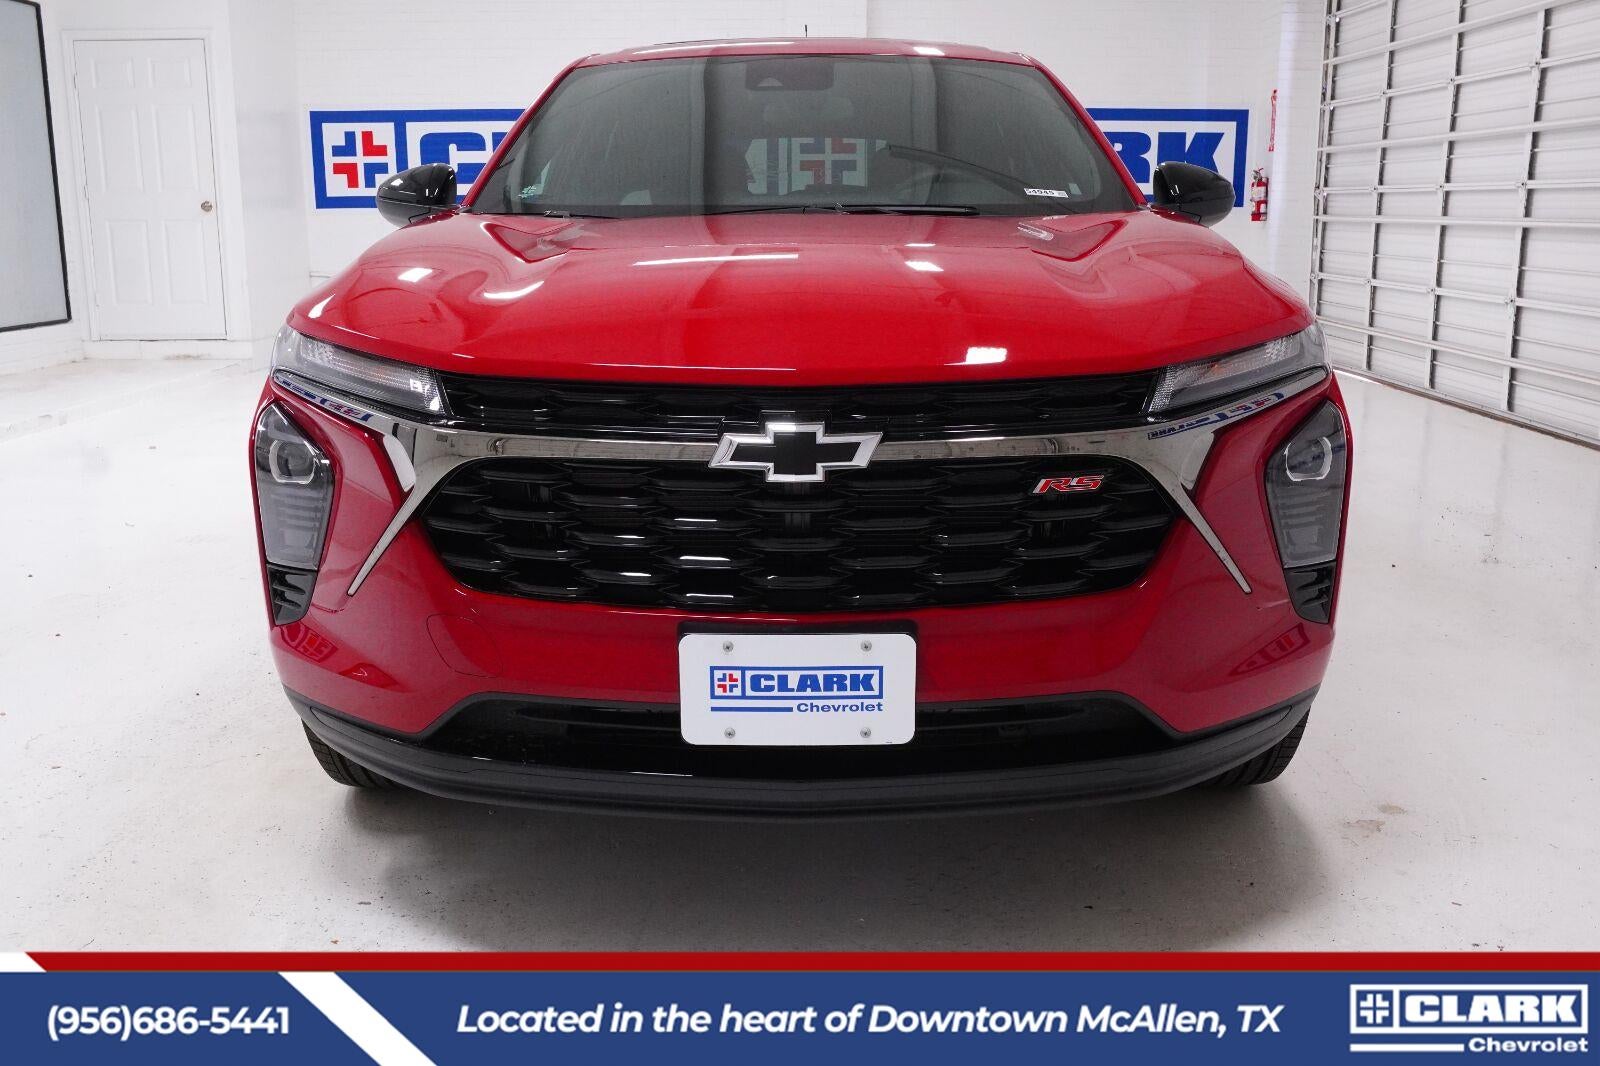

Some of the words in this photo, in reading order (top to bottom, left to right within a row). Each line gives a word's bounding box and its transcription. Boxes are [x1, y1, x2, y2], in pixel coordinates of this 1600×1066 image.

[1033, 475, 1104, 494] RS
[750, 673, 875, 693] CLARK
[796, 702, 883, 713] Chevrolet
